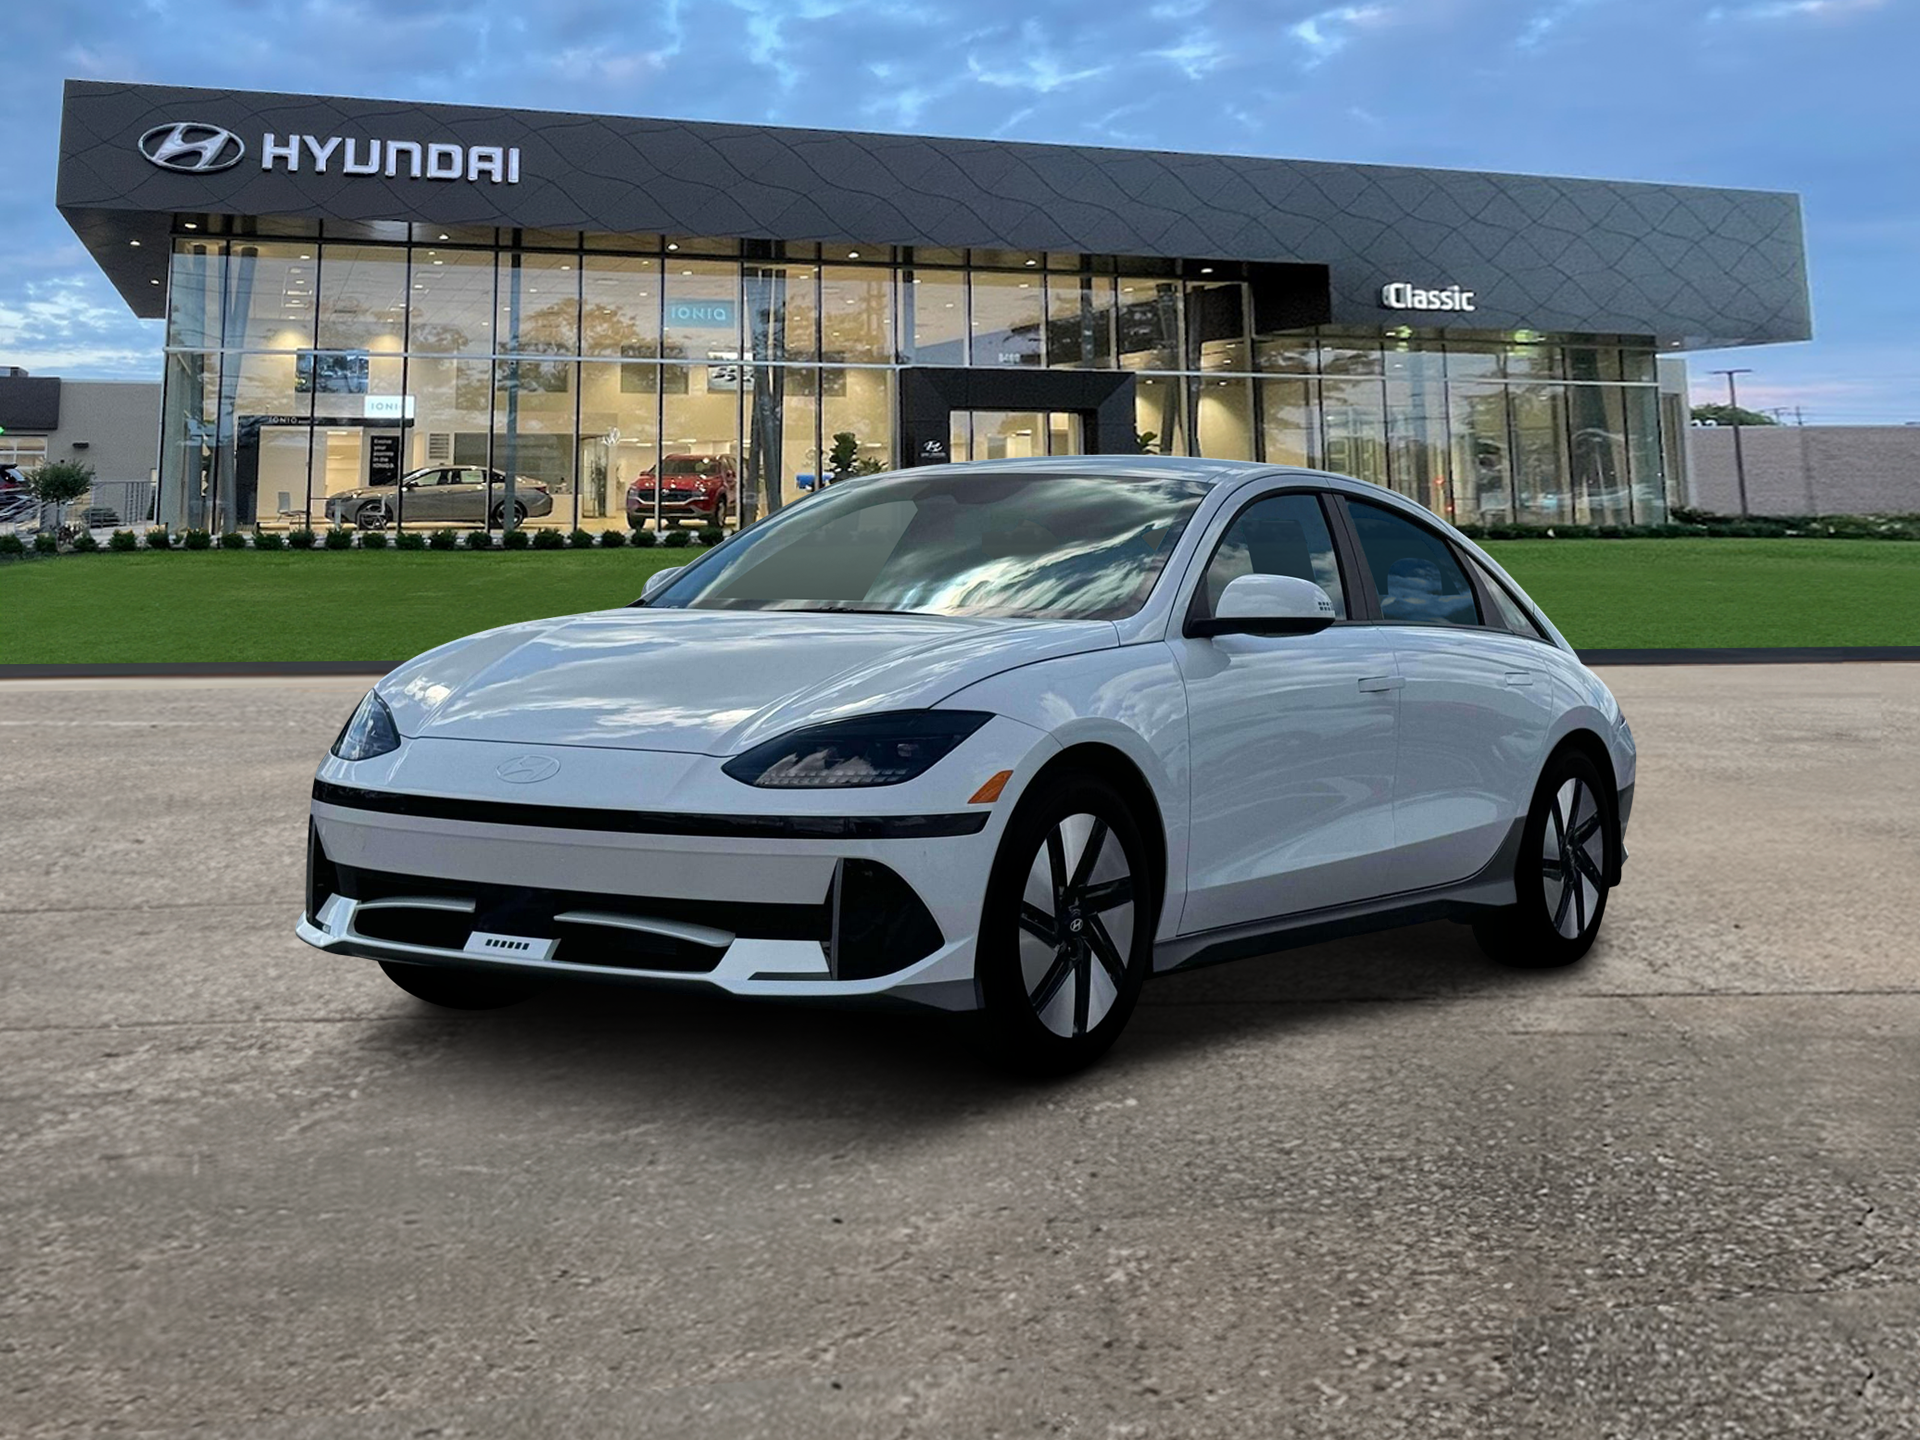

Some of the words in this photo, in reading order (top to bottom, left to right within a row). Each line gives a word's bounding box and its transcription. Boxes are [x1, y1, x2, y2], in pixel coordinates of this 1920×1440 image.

[262, 133, 520, 184] HYUNDAI
[1382, 282, 1476, 311] Classic
[671, 307, 726, 320] IONIQ
[371, 402, 404, 411] IONI
